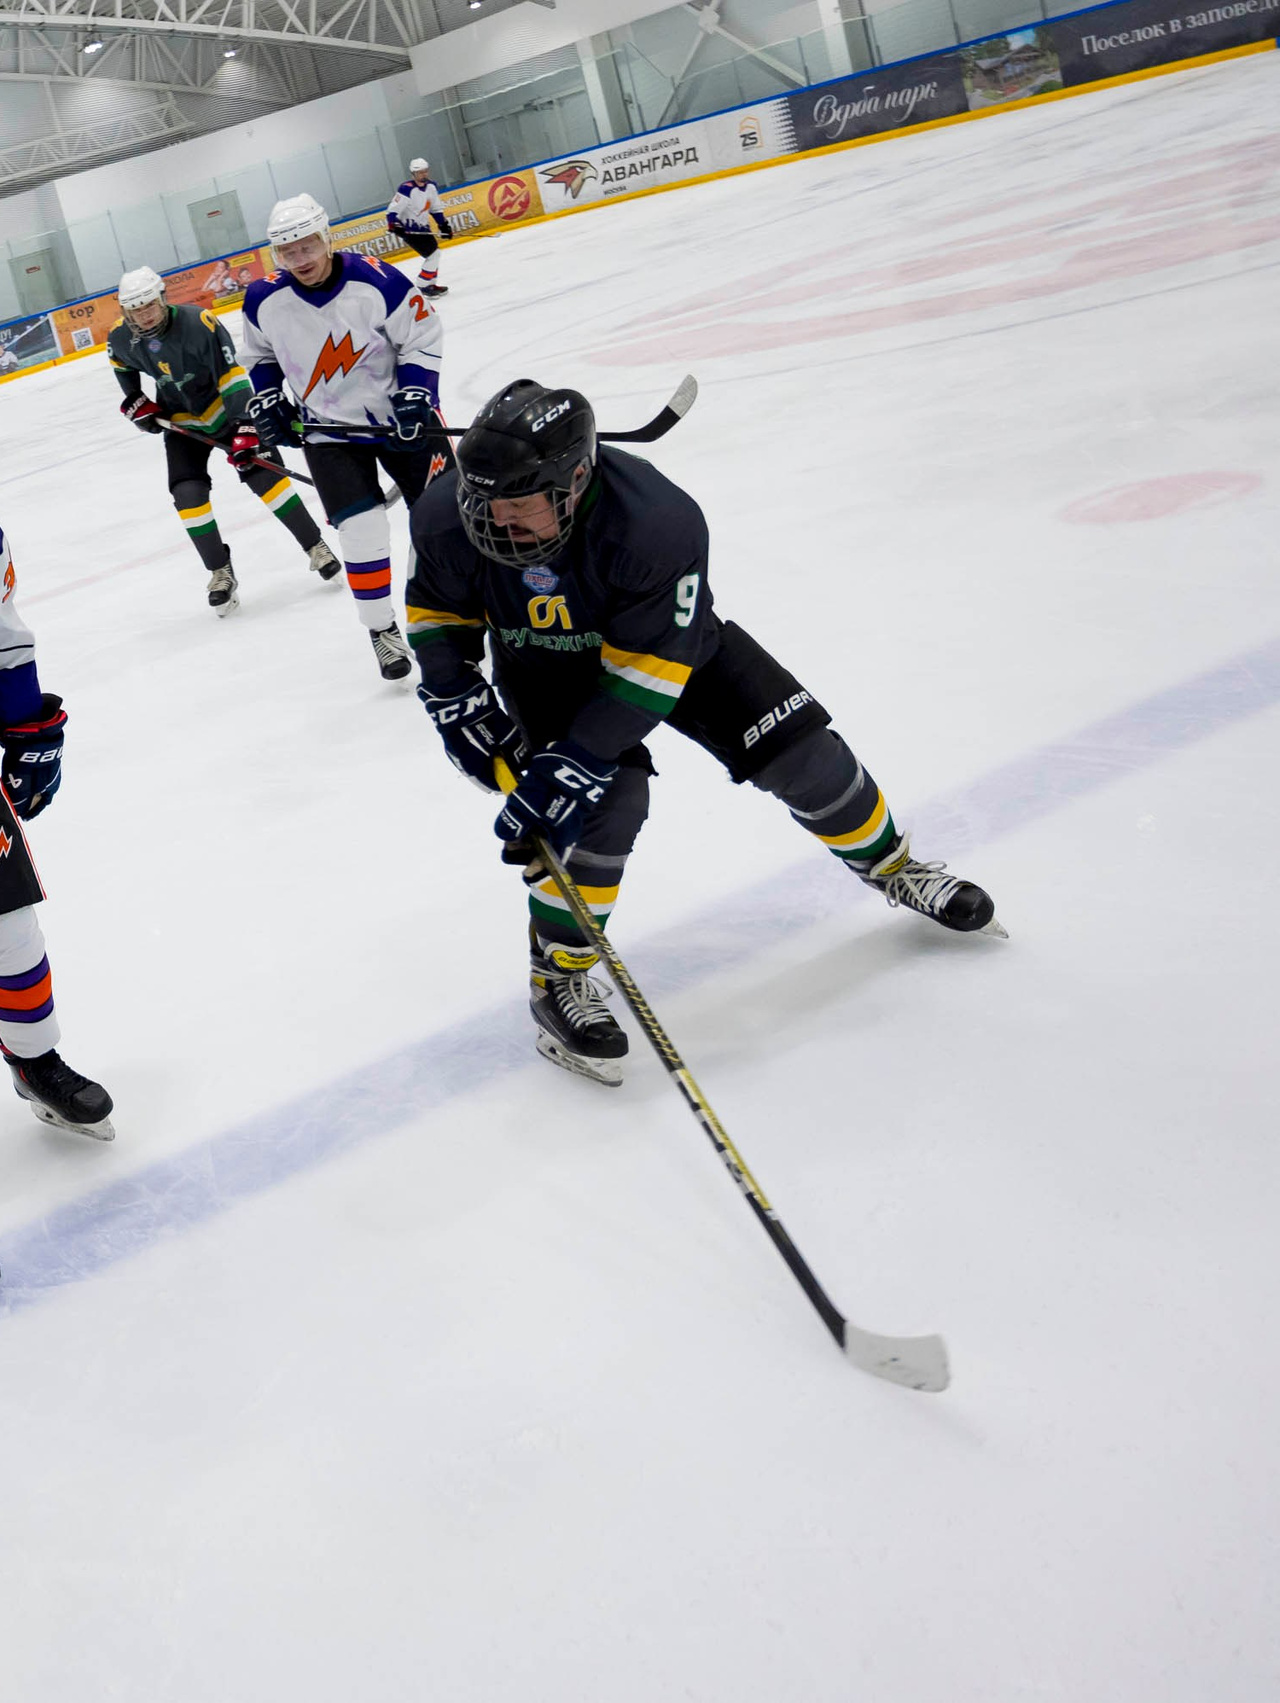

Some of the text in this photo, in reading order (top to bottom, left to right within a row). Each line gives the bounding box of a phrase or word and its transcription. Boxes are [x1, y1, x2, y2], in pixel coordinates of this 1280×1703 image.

[1081, 0, 1280, 56] Поселок в заповед
[812, 81, 938, 139] Верба парк
[601, 137, 680, 165] ХОККЕЙНАЯ ШКОЛА
[601, 147, 699, 185] АВАНГАРД
[331, 219, 387, 242] ОСКОВСКА
[447, 210, 480, 233] ИГА
[69, 303, 95, 320] top
[410, 295, 435, 321] 2
[532, 399, 571, 432] CCM
[466, 473, 495, 486] CCM
[674, 572, 699, 628] 9
[743, 690, 813, 750] BAUER
